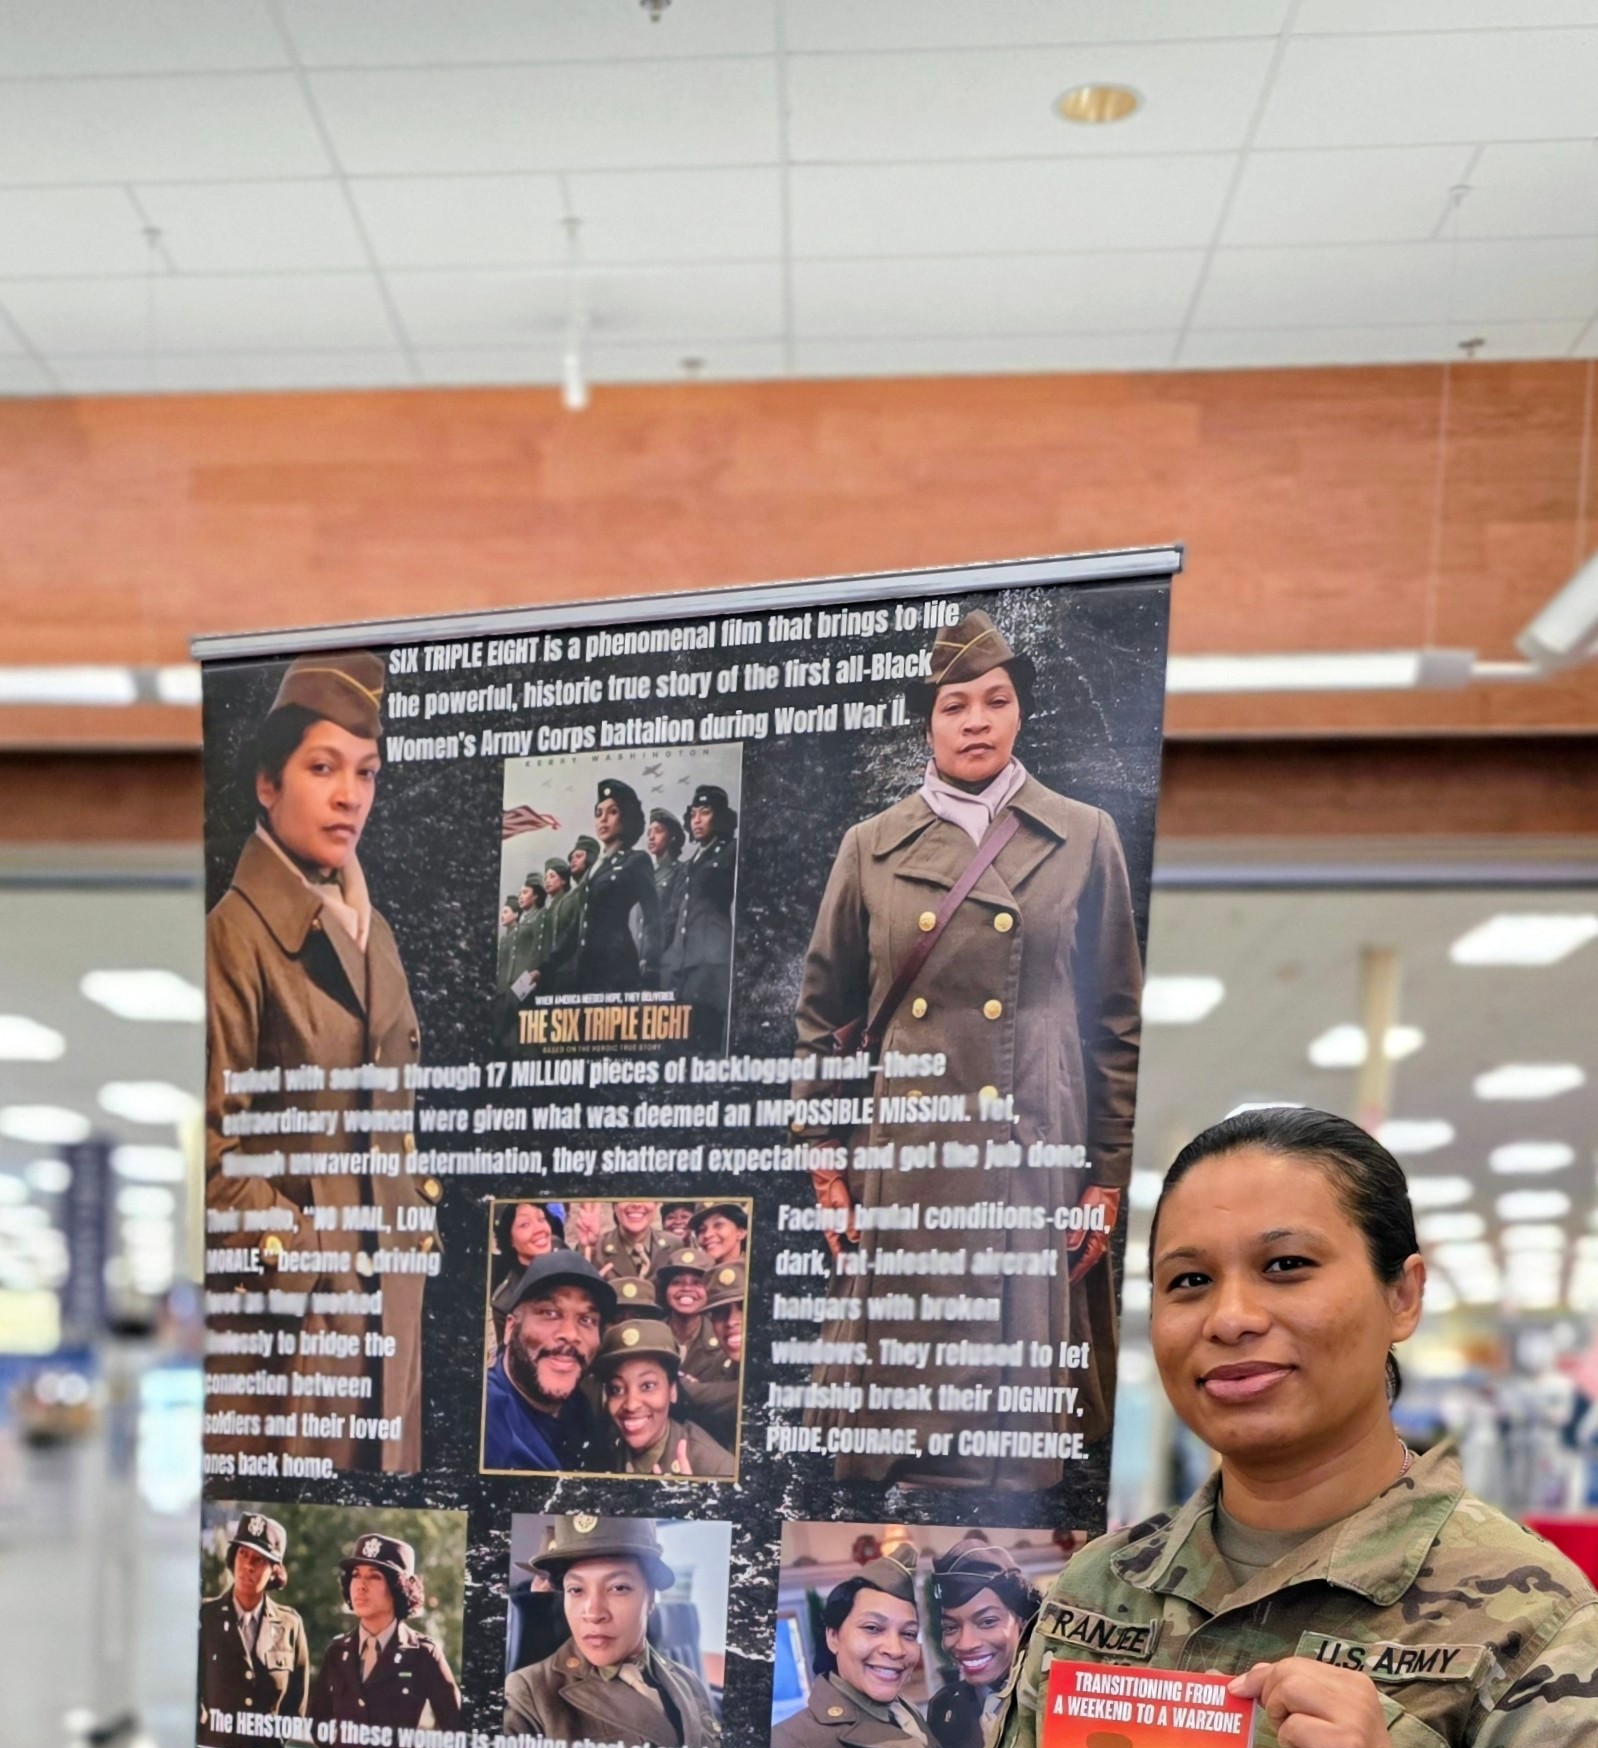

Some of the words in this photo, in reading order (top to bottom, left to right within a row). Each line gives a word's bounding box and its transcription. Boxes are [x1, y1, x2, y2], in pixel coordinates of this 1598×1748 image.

[389, 648, 418, 675] SIX
[424, 643, 483, 671] TRIPLE
[488, 637, 539, 666] EIGHT
[543, 635, 563, 662] is
[568, 637, 581, 659] a
[587, 626, 715, 657] phenomenal
[721, 619, 762, 648] film
[767, 612, 812, 643] that
[817, 608, 888, 639] brings
[894, 605, 918, 630] to
[923, 599, 959, 629] life
[389, 691, 419, 718] the
[425, 683, 518, 719] powerful,
[524, 676, 603, 707] historic
[608, 670, 651, 701] true
[656, 664, 709, 698] story
[716, 665, 740, 693] of
[745, 662, 778, 690] the
[785, 657, 830, 687] first
[835, 648, 933, 683] all-Black
[386, 732, 476, 762] Women's
[481, 728, 530, 757] Army
[537, 724, 596, 752] Corps
[601, 715, 695, 747] battalion
[700, 709, 769, 741] during
[774, 705, 838, 735] World
[843, 702, 888, 729] War
[591, 748, 709, 762] WASHINGTON
[625, 992, 640, 1003] THEY
[519, 1009, 548, 1044] THE
[551, 1009, 580, 1042] SIX
[584, 1007, 638, 1042] TRIPLE
[642, 1005, 692, 1039] EIGHT
[405, 1061, 481, 1089] through
[485, 1063, 506, 1088] 17
[511, 1059, 584, 1087] MILLION
[590, 1056, 660, 1087] pieces
[665, 1057, 686, 1082] of
[691, 1054, 815, 1085] backlogged
[420, 1107, 468, 1132] were
[473, 1103, 528, 1134] given
[533, 1101, 581, 1130] what
[587, 1102, 628, 1128] was
[634, 1099, 718, 1128] deemed
[724, 1105, 750, 1126] an
[756, 1099, 874, 1126] IMPOSSIBLE
[879, 1095, 971, 1125] MISSION.
[406, 1150, 548, 1176] determination,
[553, 1146, 597, 1175] they
[602, 1146, 703, 1173] shattered
[708, 1142, 848, 1175] expectations
[397, 1207, 437, 1231] LOW
[779, 1204, 849, 1232] Facing
[278, 1250, 349, 1273] became
[372, 1247, 441, 1276] driving
[776, 1249, 831, 1277] dark,
[278, 1331, 295, 1355] to
[300, 1331, 360, 1358] bridge
[365, 1332, 396, 1357] the
[879, 1338, 931, 1369] They
[1059, 1343, 1090, 1369] let
[292, 1373, 372, 1398] between
[869, 1384, 932, 1411] break
[938, 1384, 992, 1411] their
[998, 1387, 1084, 1417] DIGNITY,
[265, 1414, 296, 1437] and
[302, 1414, 345, 1439] their
[349, 1415, 402, 1440] loved
[929, 1433, 953, 1455] or
[958, 1430, 1089, 1460] CONFIDENCE.
[238, 1452, 278, 1476] back
[282, 1453, 338, 1479] home.
[1052, 1610, 1151, 1652] RANJEE
[1317, 1641, 1365, 1671] U.S.
[1372, 1647, 1460, 1674] ARMY
[1075, 1672, 1182, 1701] TRANSITIONING
[1185, 1683, 1226, 1706] FROM
[210, 1708, 232, 1733] The
[237, 1714, 312, 1740] HERSTORY
[318, 1719, 336, 1743] of
[341, 1720, 391, 1746] these
[1053, 1695, 1063, 1715] A
[1068, 1696, 1132, 1722] WEEKEND
[1137, 1703, 1154, 1724] TO
[1157, 1706, 1167, 1726] A
[1172, 1707, 1243, 1734] WARZONE
